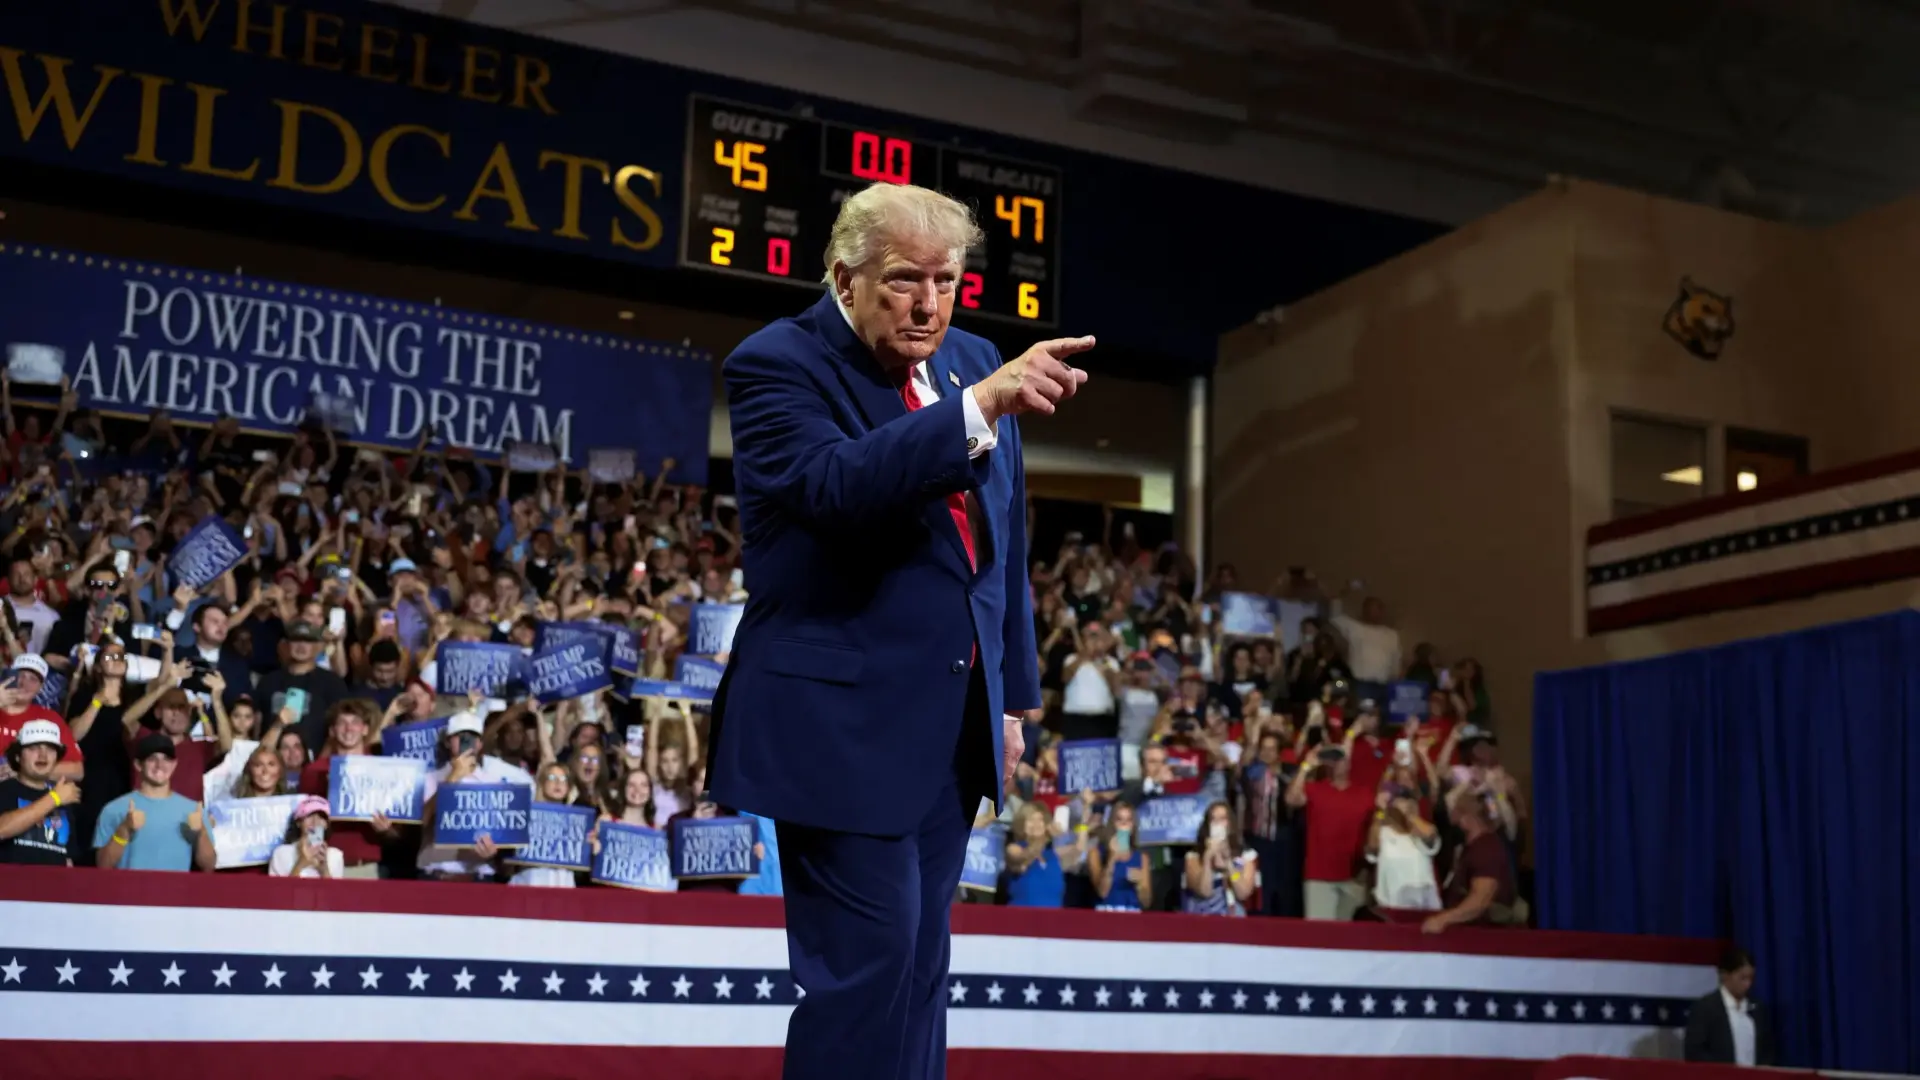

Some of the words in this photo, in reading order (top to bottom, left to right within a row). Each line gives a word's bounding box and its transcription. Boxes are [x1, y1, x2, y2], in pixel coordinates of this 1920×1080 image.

[158, 0, 560, 116] WHEELER
[711, 108, 789, 142] GUEST
[0, 44, 663, 250] WILDCATS
[713, 138, 769, 193] 45
[994, 194, 1046, 244] 47
[710, 226, 736, 266] 2
[765, 236, 792, 277] 0
[960, 270, 984, 310] 2
[1017, 280, 1041, 319] 6
[117, 279, 424, 379] POWERING
[434, 326, 543, 397] THE
[72, 340, 376, 435] AMERICAN
[385, 381, 575, 464] DREAM
[529, 656, 605, 697] ACCOUNTS
[533, 644, 585, 677] TRUMP
[439, 809, 527, 831] ACCOUNTS
[454, 790, 515, 810] TRUMP
[601, 854, 674, 887] DREAM
[682, 849, 753, 874] DREAM
